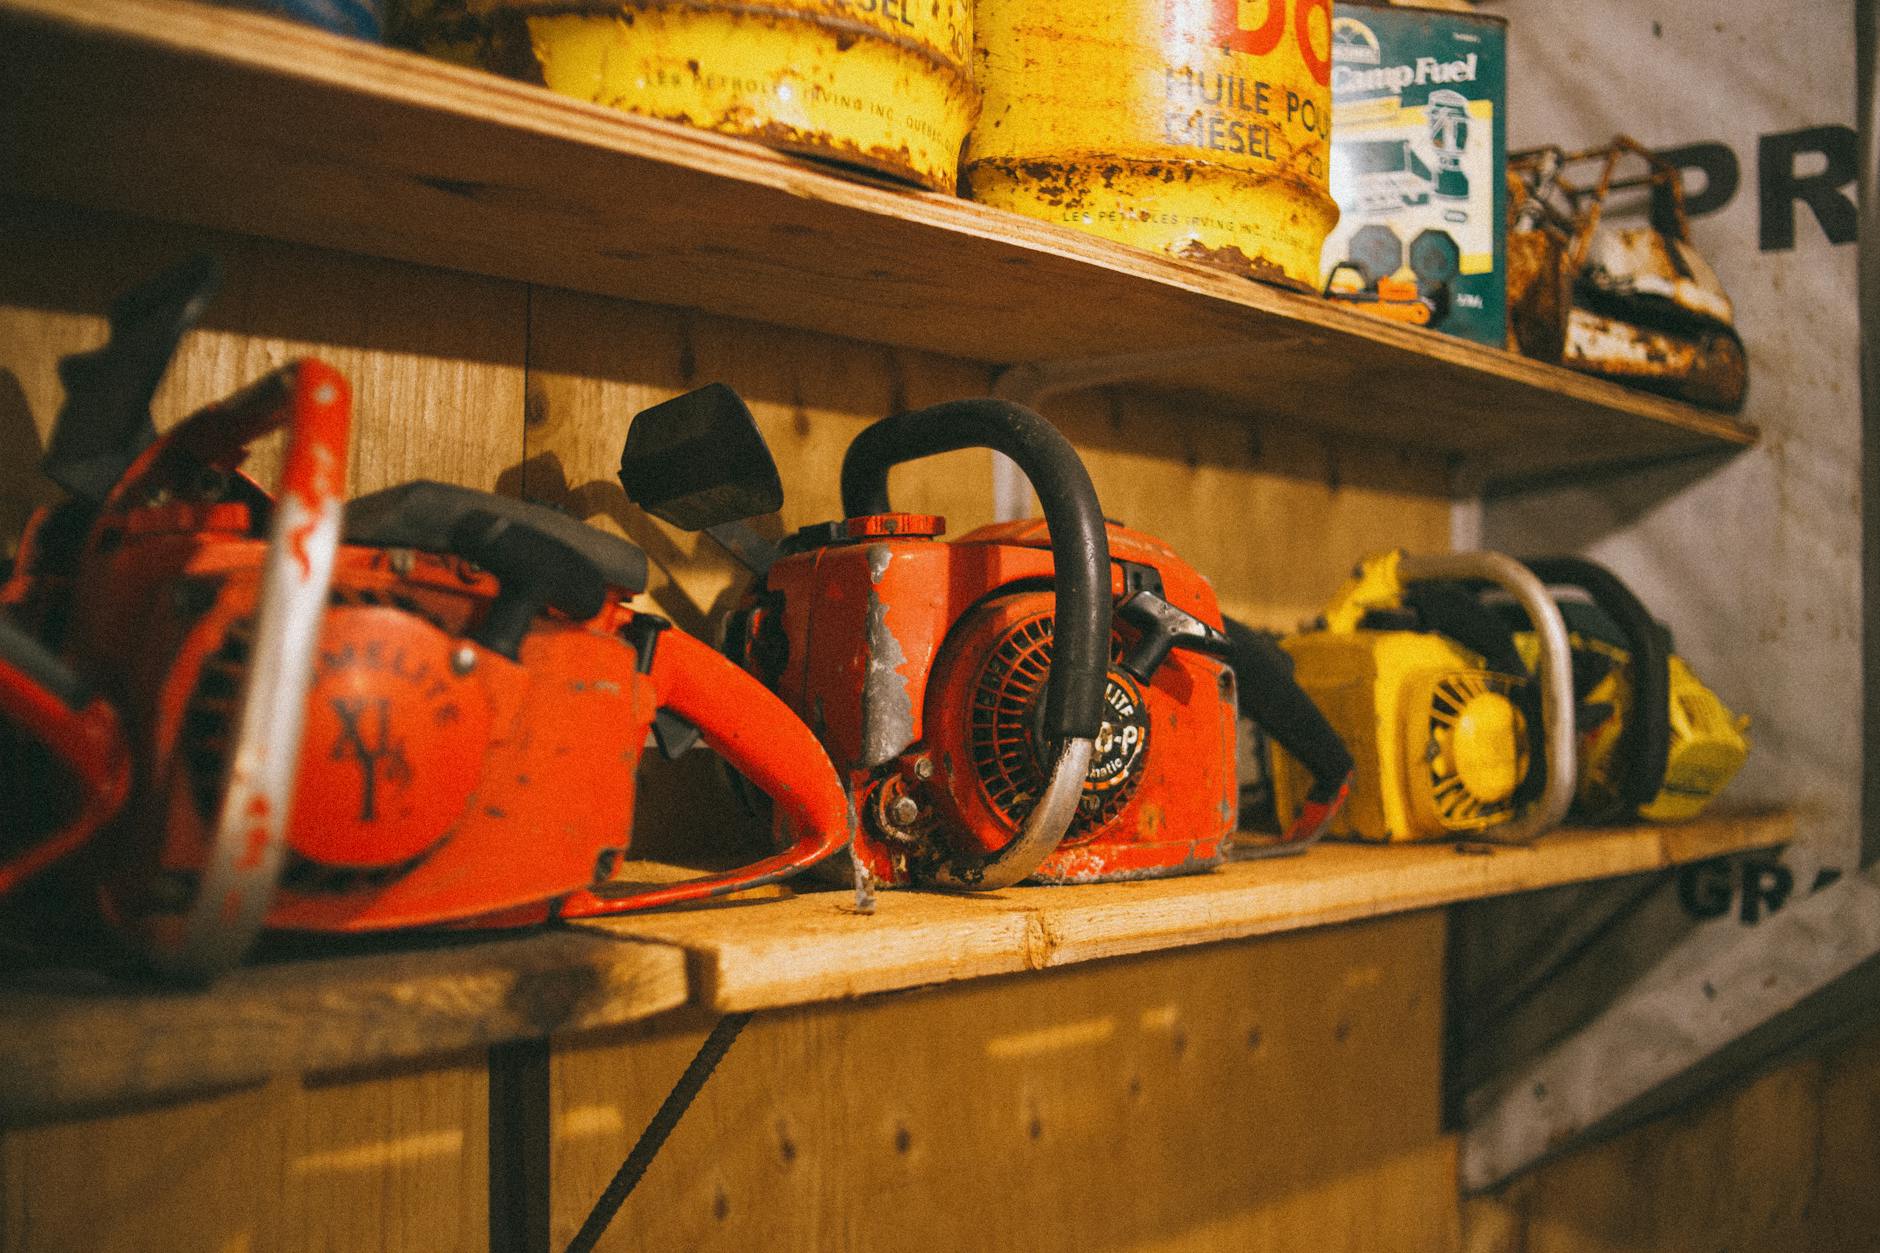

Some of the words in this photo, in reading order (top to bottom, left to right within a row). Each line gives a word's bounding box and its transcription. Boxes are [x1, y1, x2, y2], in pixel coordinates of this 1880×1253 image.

[1414, 52, 1478, 86] Fuel
[1166, 68, 1271, 116] HUILE
[1063, 211, 1090, 223] LES
